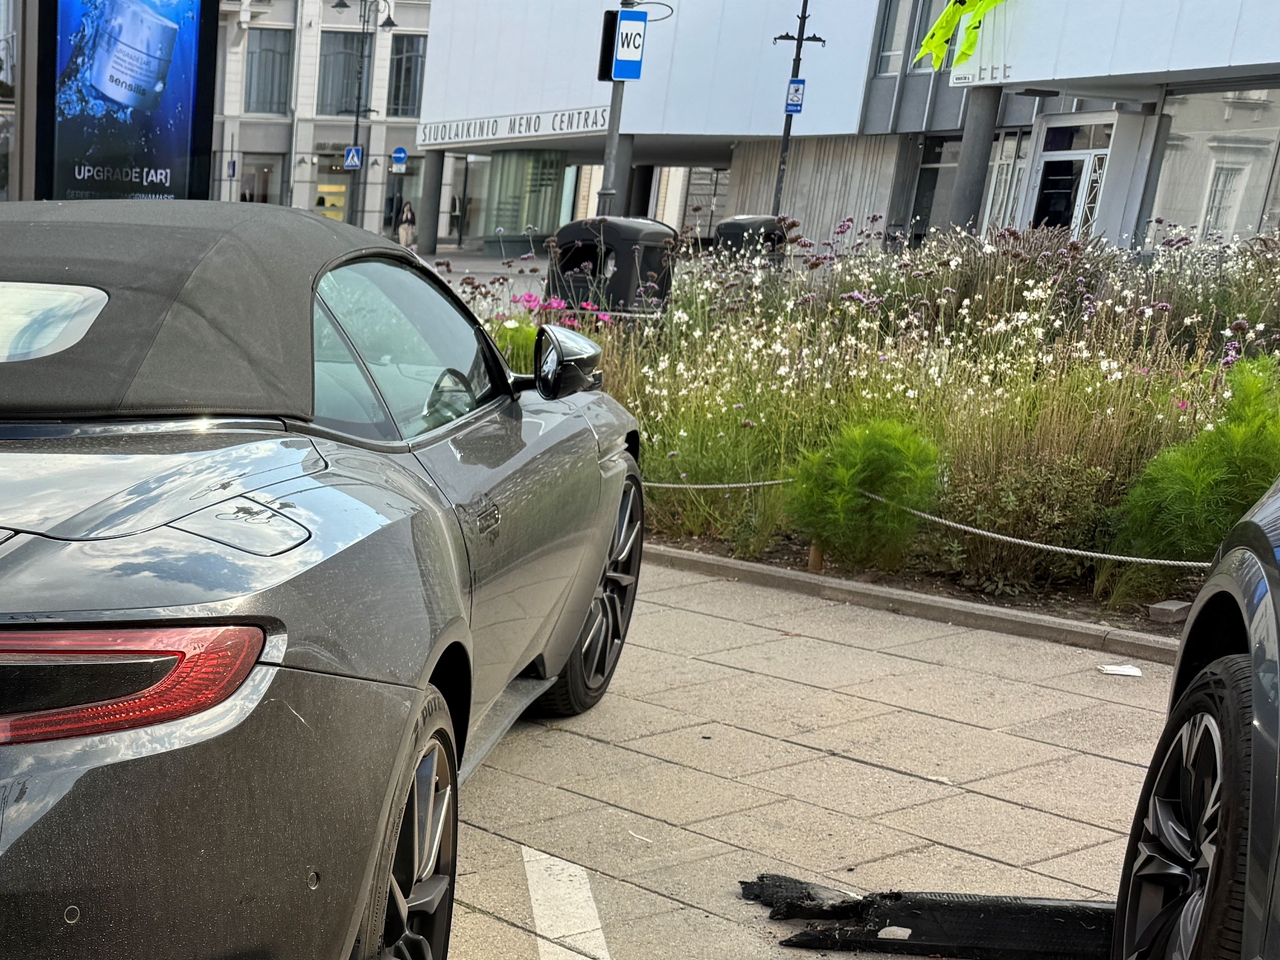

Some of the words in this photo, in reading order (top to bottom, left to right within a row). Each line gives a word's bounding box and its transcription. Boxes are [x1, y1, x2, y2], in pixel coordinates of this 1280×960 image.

[620, 32, 642, 49] WC
[108, 74, 147, 97] sensilis
[508, 115, 541, 135] MENO
[552, 108, 607, 132] CENTRAS
[74, 165, 140, 182] UPGRADE
[142, 167, 171, 187] [AR]
